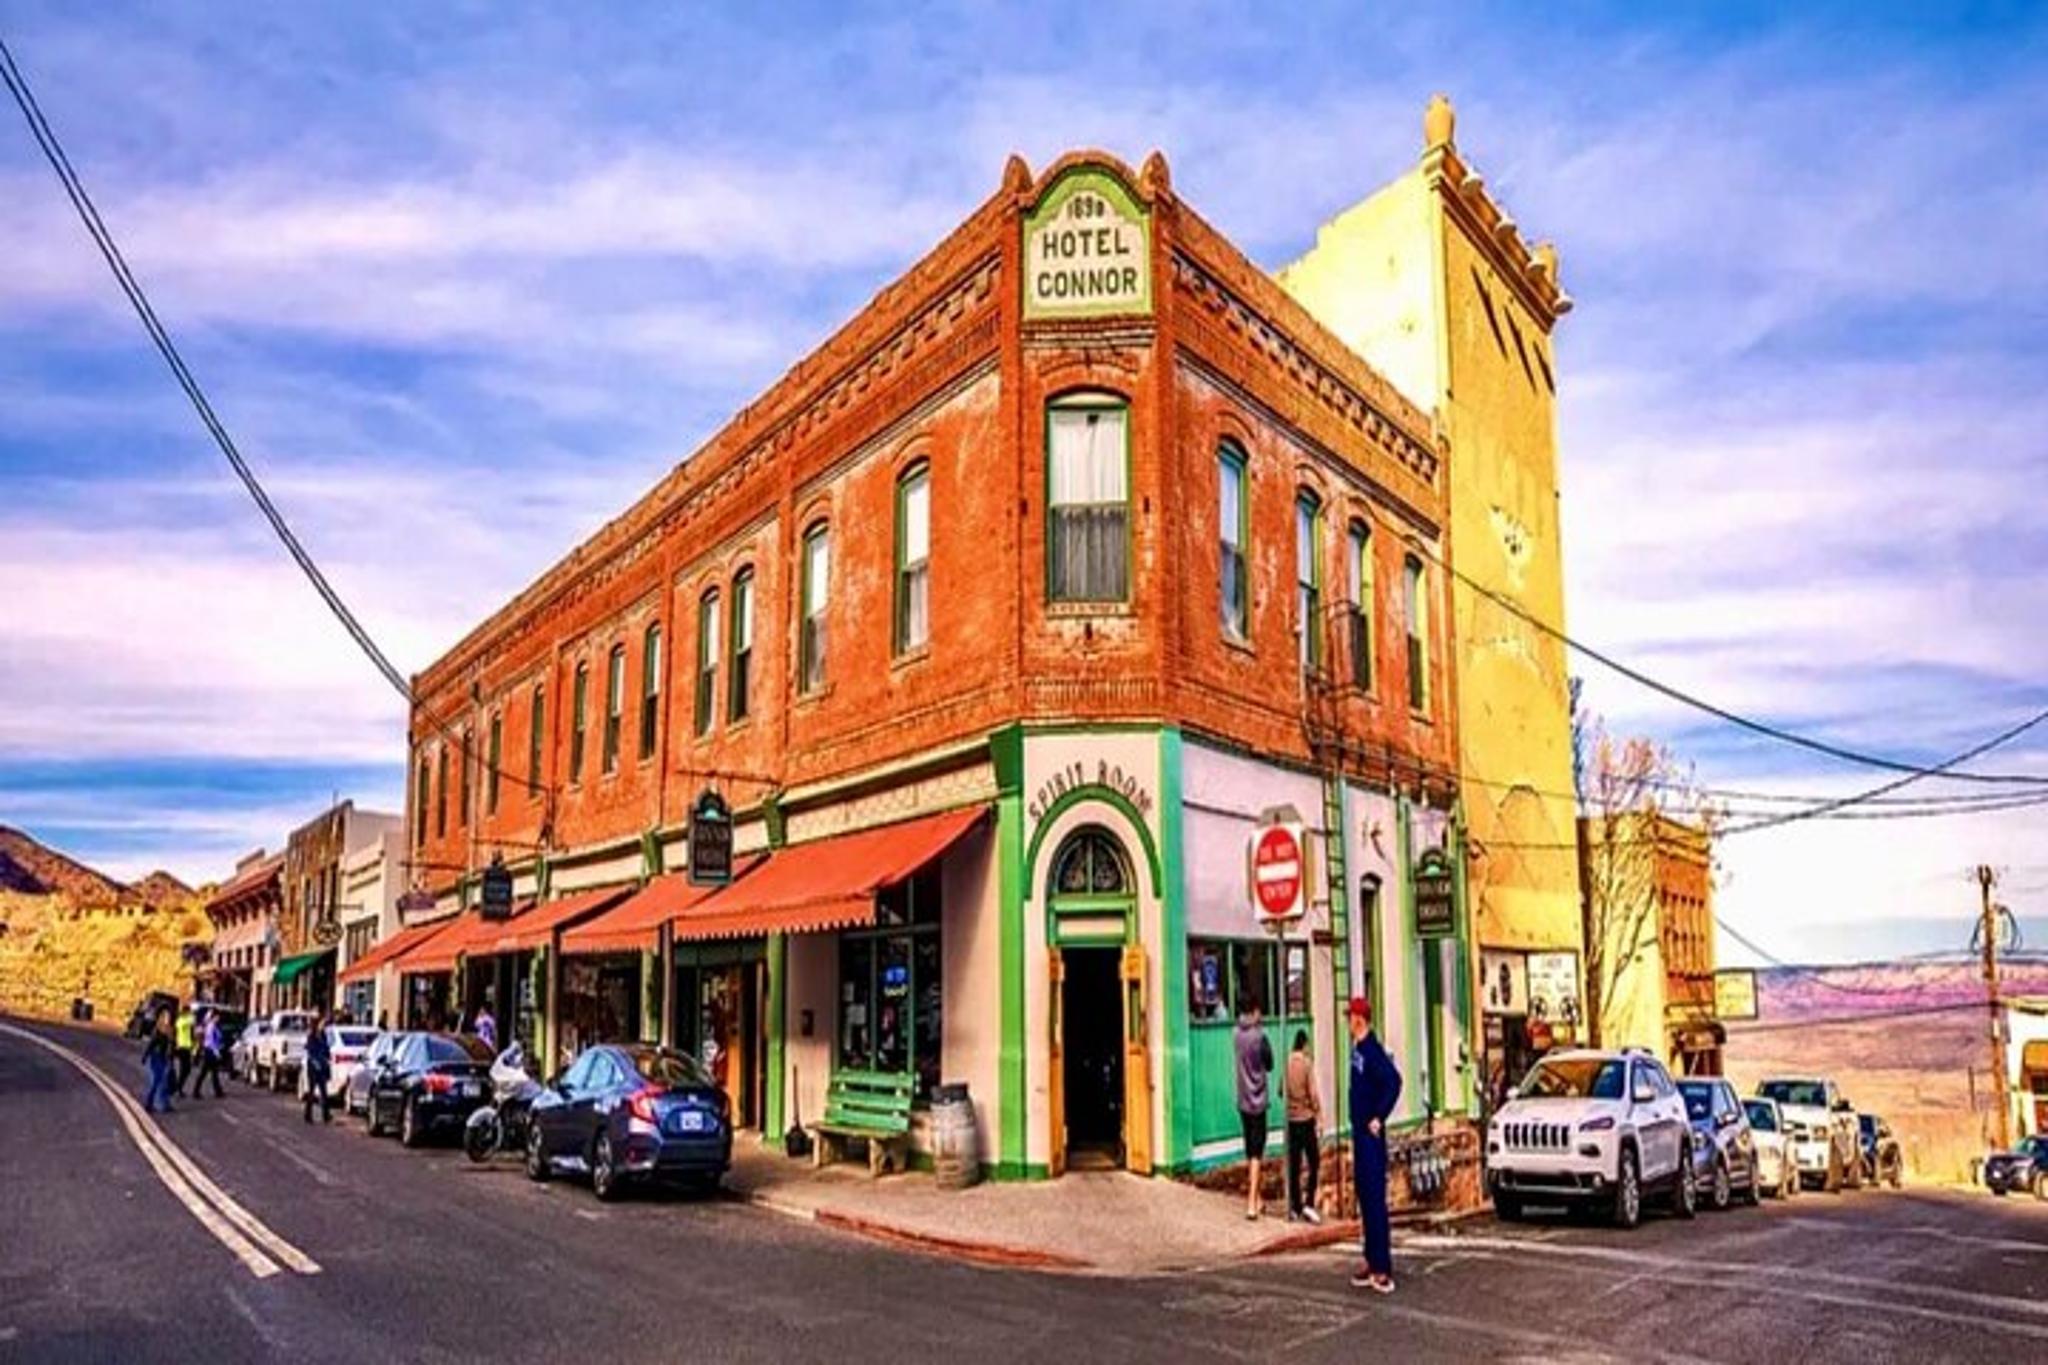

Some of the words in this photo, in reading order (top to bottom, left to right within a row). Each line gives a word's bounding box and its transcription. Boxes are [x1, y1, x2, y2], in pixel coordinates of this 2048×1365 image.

[1043, 228, 1130, 259] HOTEL
[1037, 267, 1138, 298] CONNOR
[1028, 761, 1085, 820] SPIRIT
[1098, 759, 1153, 817] ROOM
